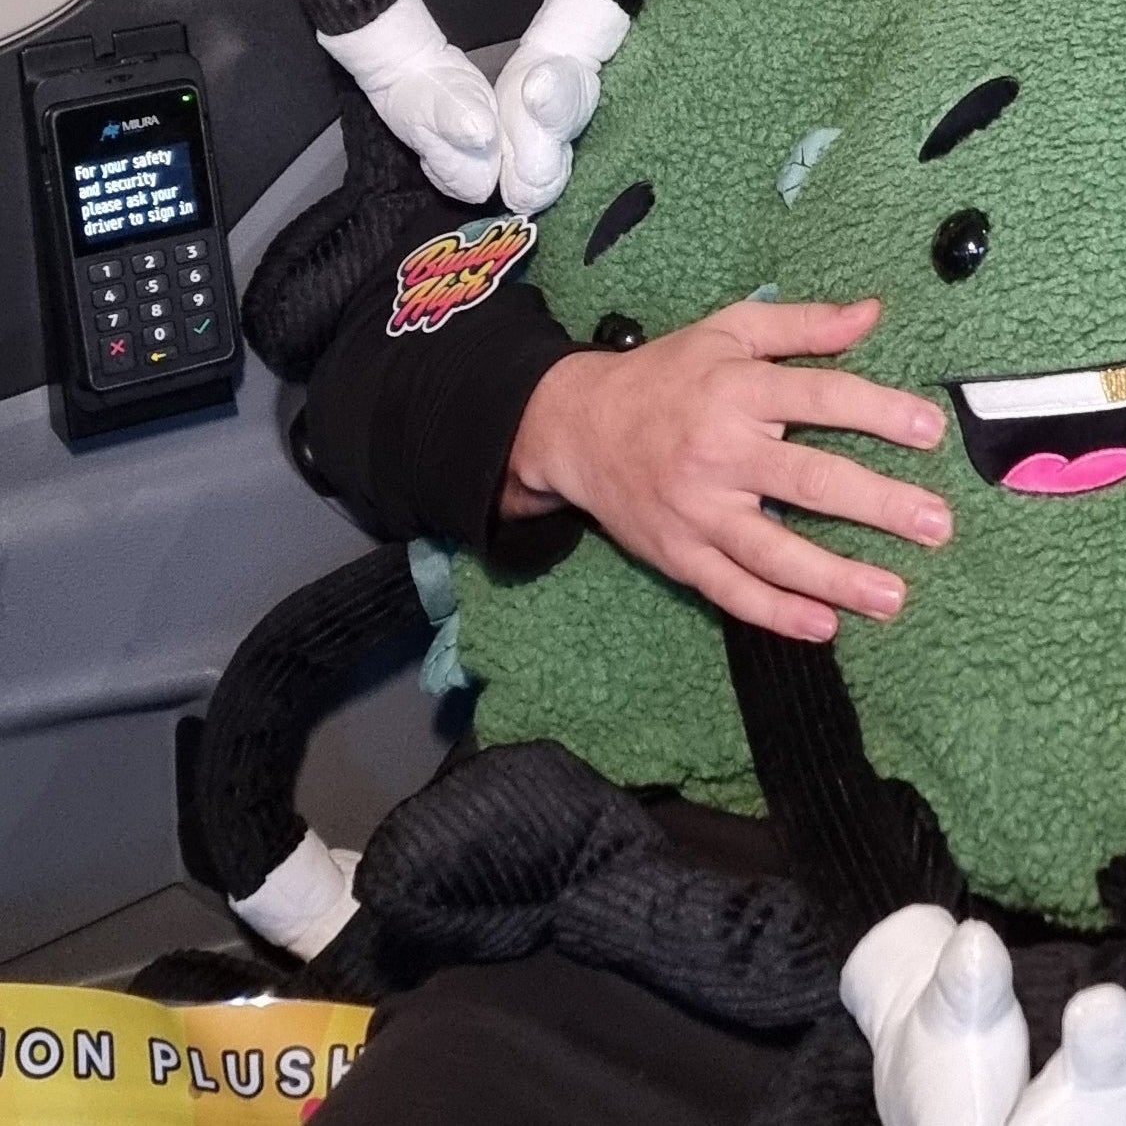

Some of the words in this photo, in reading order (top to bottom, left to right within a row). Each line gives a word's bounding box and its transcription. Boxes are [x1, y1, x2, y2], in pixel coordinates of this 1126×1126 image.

[121, 115, 160, 131] MIURA
[74, 165, 97, 181] For
[100, 159, 128, 178] your
[132, 150, 172, 169] safety
[79, 181, 101, 199] and
[104, 172, 158, 194] security
[81, 199, 123, 221] please
[125, 191, 148, 208] ask
[151, 186, 179, 206] your
[83, 217, 125, 237] driver
[128, 213, 144, 226] to
[147, 206, 175, 223] sign
[178, 200, 194, 216] in
[102, 265, 111, 278] 1
[144, 255, 155, 269] 2
[186, 245, 198, 259] 3
[402, 220, 530, 286] Buddy
[104, 289, 116, 302] 4
[148, 279, 159, 293] 5
[189, 269, 201, 283] 6
[393, 258, 492, 328] High
[107, 313, 119, 327] 7
[151, 304, 162, 317] 8
[192, 293, 204, 306] 9
[154, 327, 166, 341] 0
[0, 1026, 115, 1081] ON
